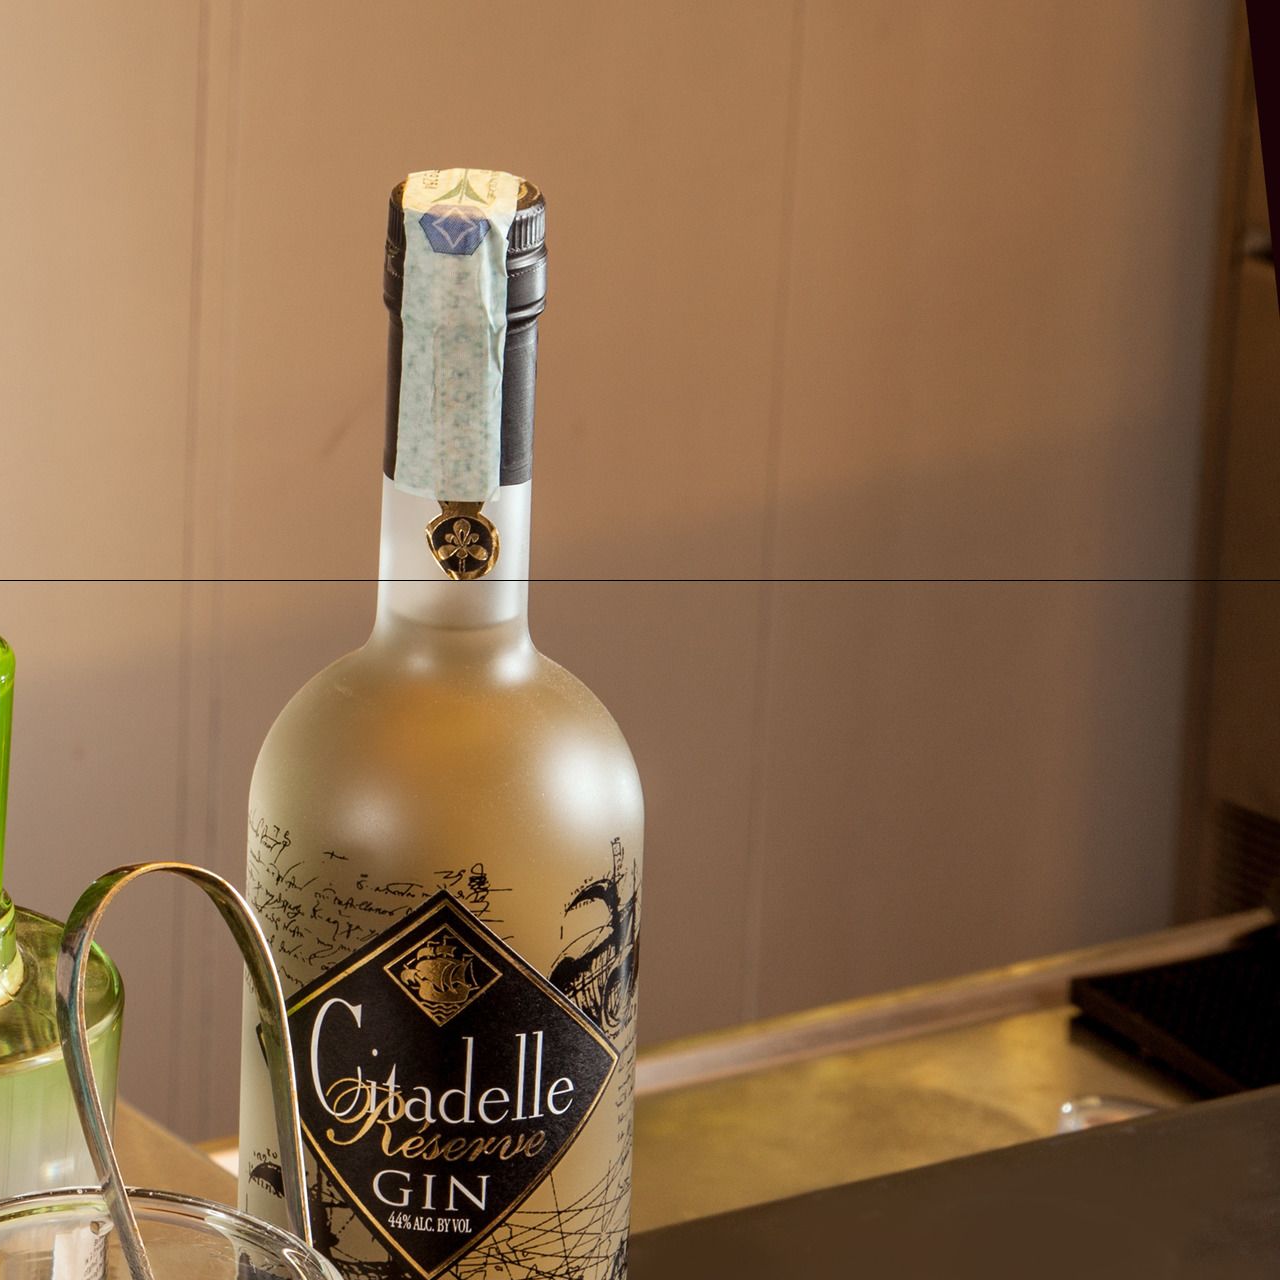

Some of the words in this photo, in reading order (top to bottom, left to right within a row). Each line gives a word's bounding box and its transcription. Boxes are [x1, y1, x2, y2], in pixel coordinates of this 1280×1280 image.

[310, 997, 575, 1125] Citadelle
[326, 1077, 546, 1163] Réserve
[372, 1169, 491, 1212] GIN
[388, 1211, 412, 1231] 44%
[413, 1216, 435, 1232] ALC.
[437, 1217, 451, 1234] BY
[451, 1217, 472, 1234] VOL
